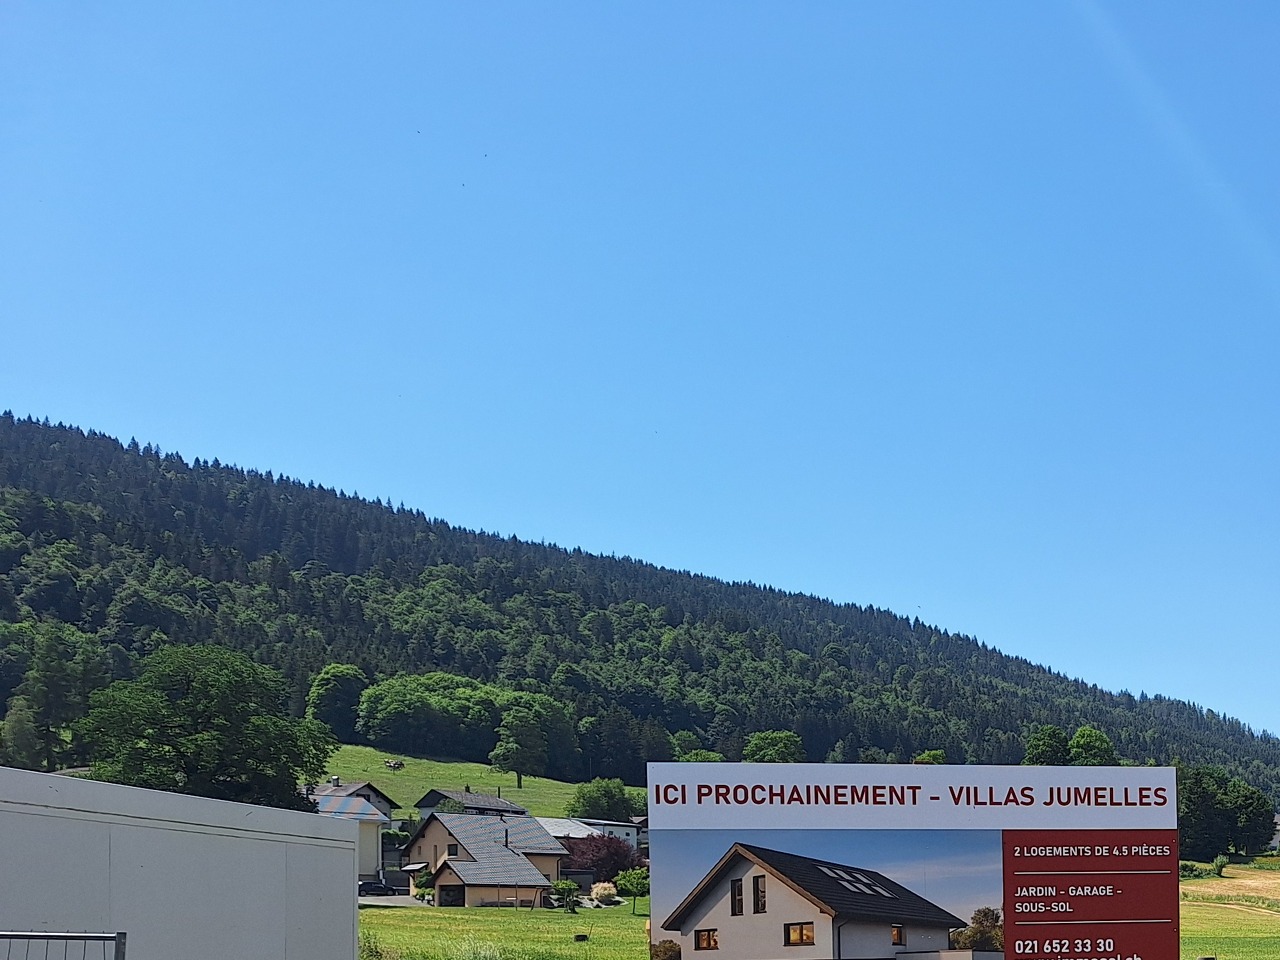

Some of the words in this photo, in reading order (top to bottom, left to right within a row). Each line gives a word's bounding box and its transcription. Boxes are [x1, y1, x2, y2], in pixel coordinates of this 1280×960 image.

[654, 784, 687, 805] ICI
[697, 784, 922, 806] PROCHAINEMENT
[948, 786, 1035, 806] VILLAS
[1042, 786, 1168, 807] JUMELLES
[1014, 846, 1021, 856] 2
[1023, 846, 1092, 857] LOGEMENTS
[1094, 846, 1110, 856] DE
[1112, 845, 1129, 856] 4.5
[1131, 843, 1171, 856] PIÈCES
[1014, 886, 1056, 897] JARDIN
[1068, 886, 1114, 896] GARAGE
[1014, 902, 1074, 913] SOUS-SOL
[1014, 940, 1038, 954] 021
[1043, 939, 1070, 953] 652
[1074, 939, 1092, 952] 33
[1096, 938, 1114, 952] 30
